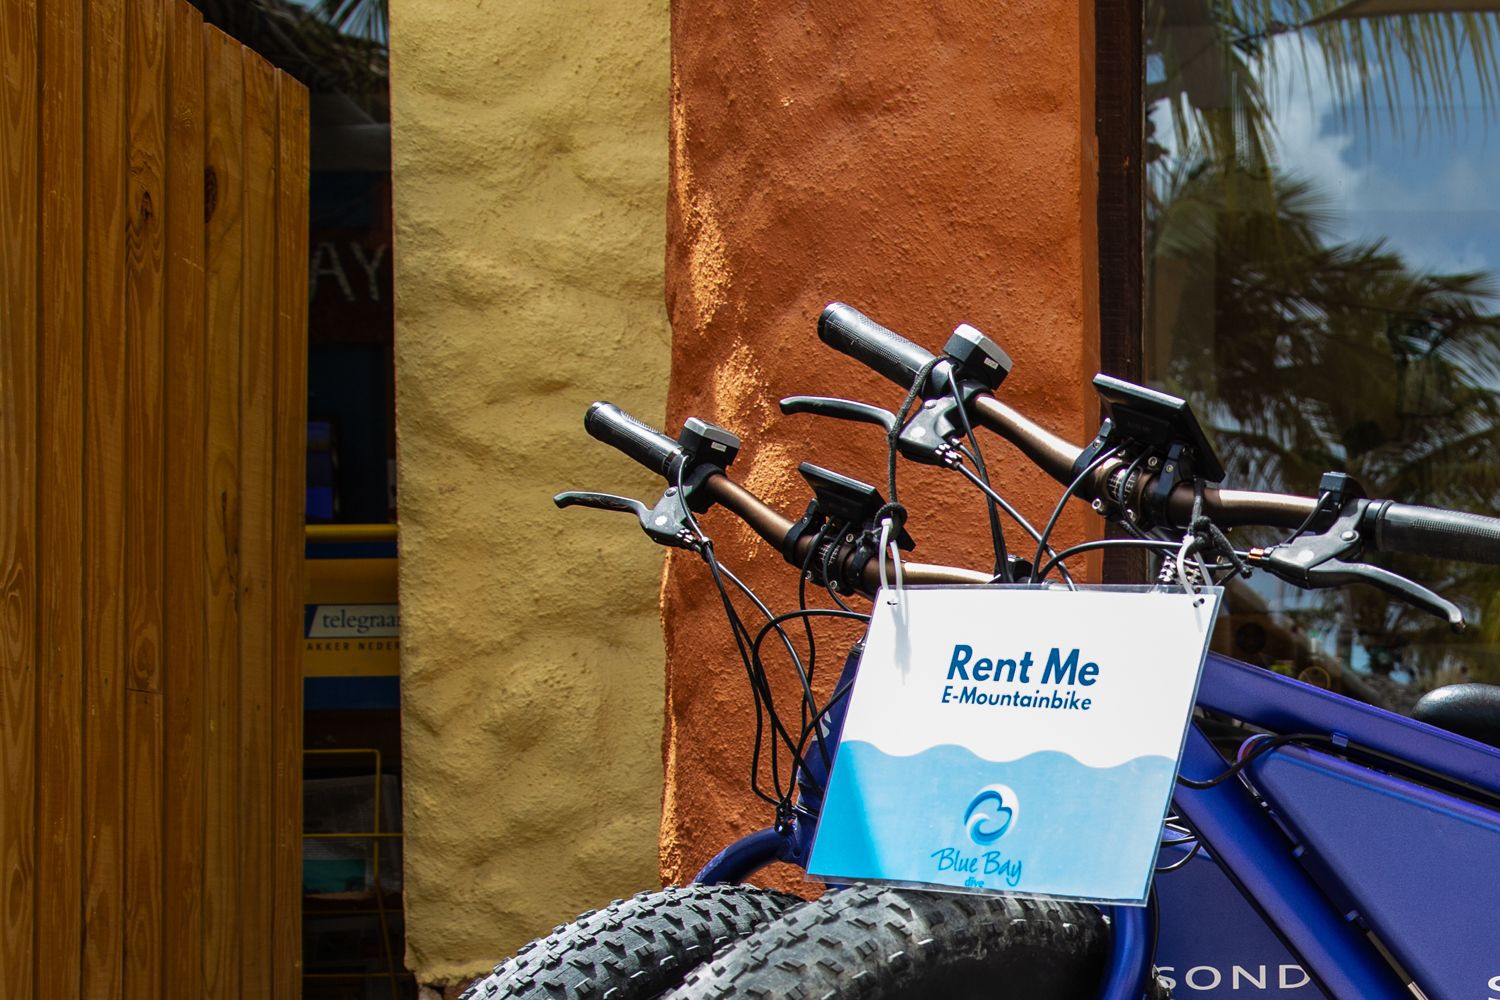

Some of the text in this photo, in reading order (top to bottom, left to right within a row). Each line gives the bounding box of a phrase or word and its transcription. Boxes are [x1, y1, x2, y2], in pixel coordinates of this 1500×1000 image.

[947, 644, 1100, 686] Rent Me
[941, 685, 1092, 710] E-Mountainbike
[931, 848, 1022, 887] Blue Bay
[1156, 964, 1311, 991] SOND
